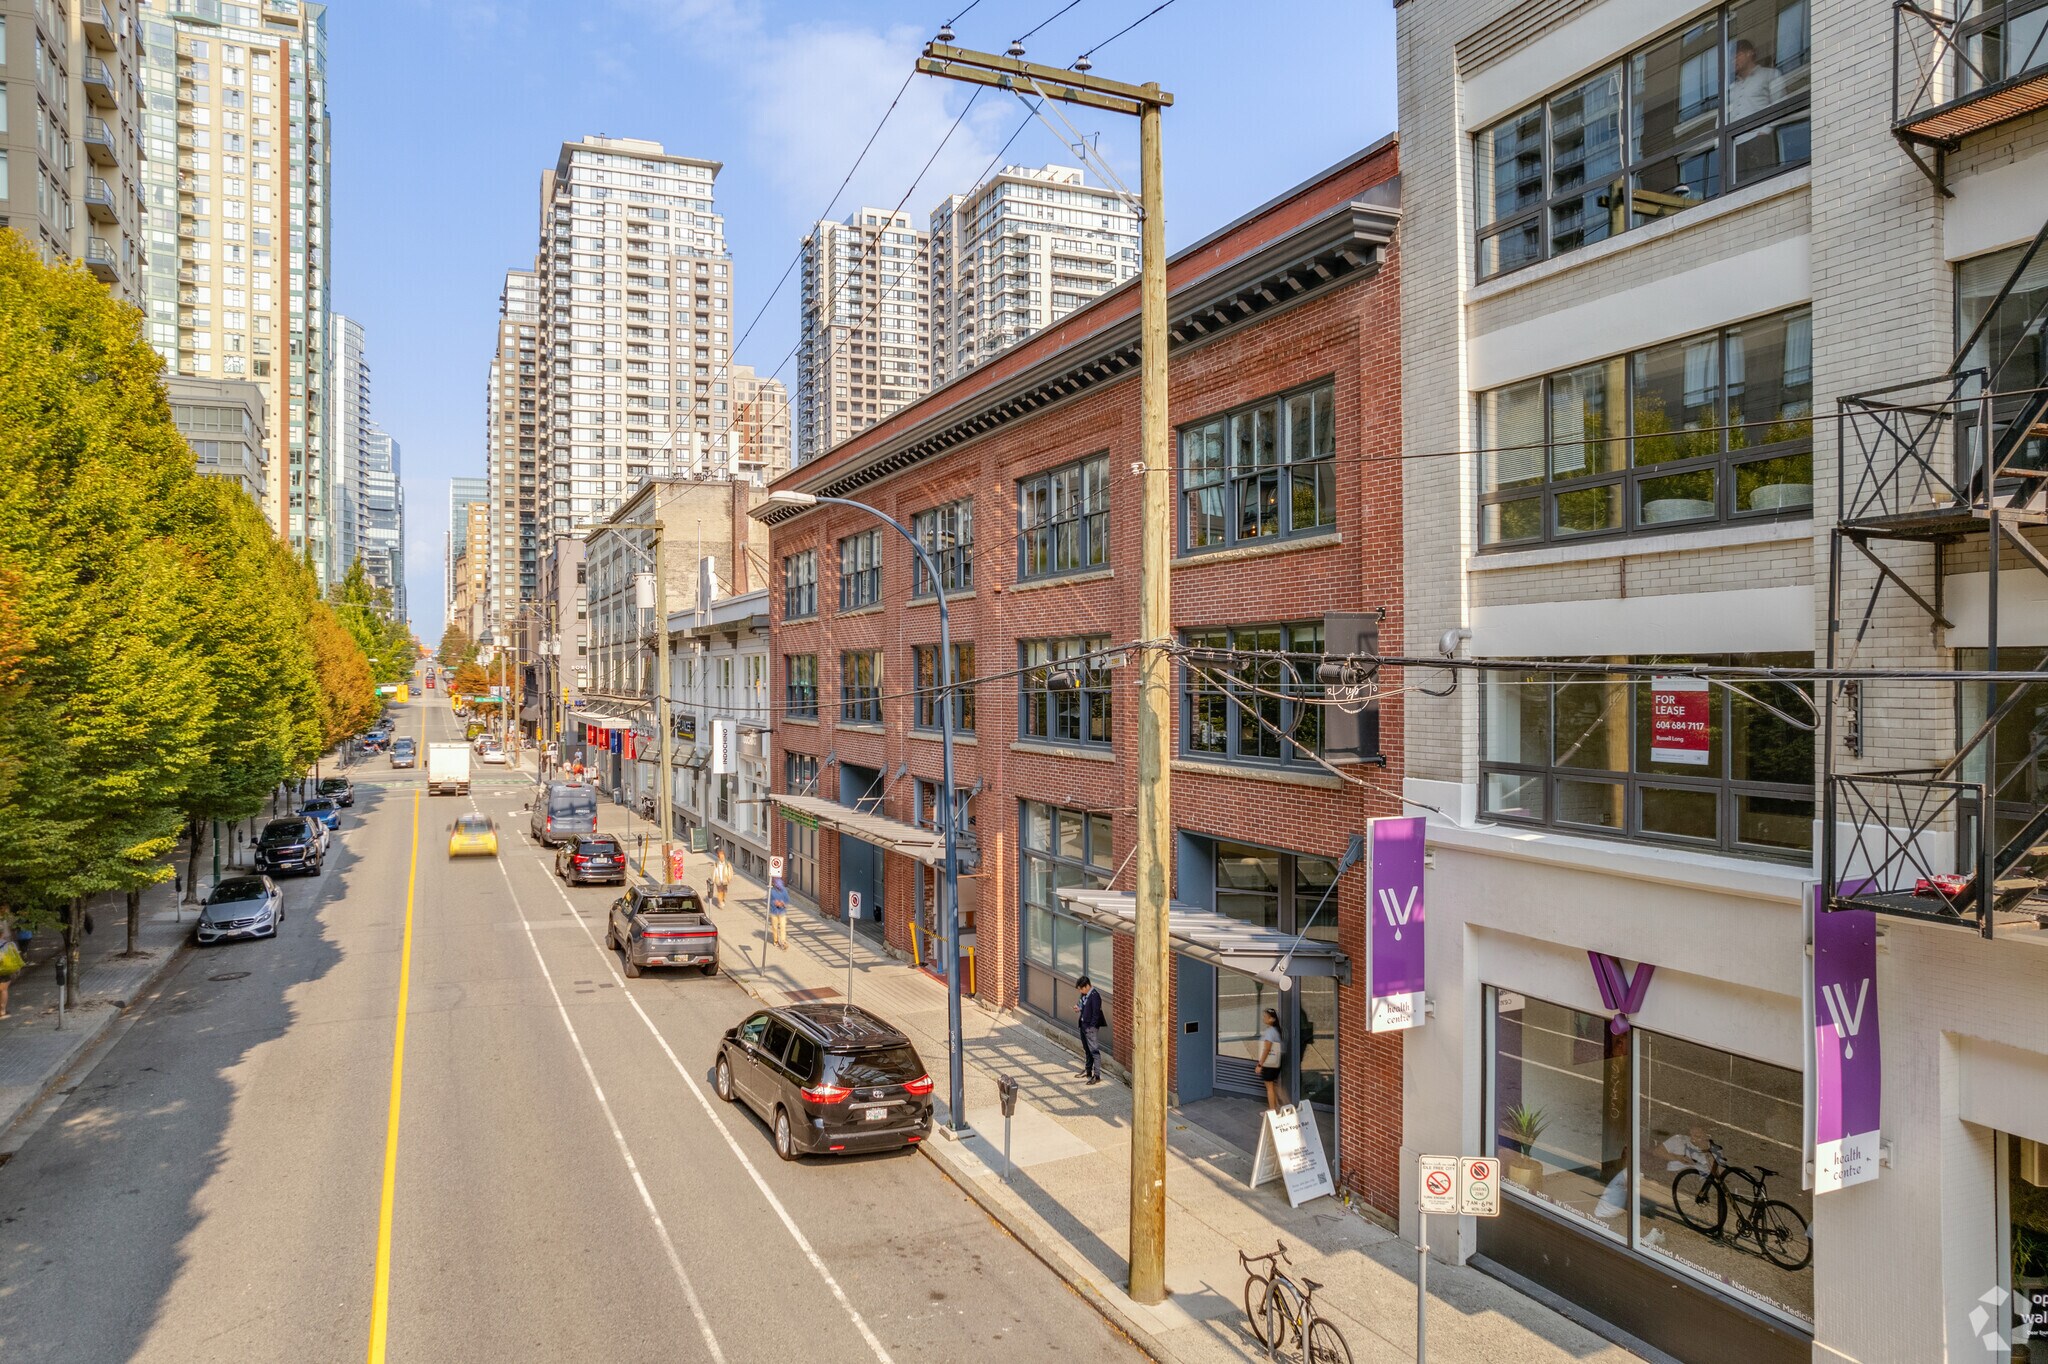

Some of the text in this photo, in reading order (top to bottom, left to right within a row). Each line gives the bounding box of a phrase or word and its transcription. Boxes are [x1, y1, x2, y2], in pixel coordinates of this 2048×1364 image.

[1655, 695, 1675, 704] FOR
[1655, 706, 1685, 715] LEASE
[1656, 721, 1704, 731] 604 684 7117
[1387, 1002, 1410, 1013] health
[1387, 1014, 1411, 1024] centre
[1834, 1146, 1861, 1165] health
[1833, 1165, 1861, 1180] centre
[1500, 1176, 1529, 1193] Osteopathy
[1536, 1190, 1549, 1200] RMT
[1563, 1202, 1584, 1217] Vitamin
[1586, 1212, 1610, 1229] Therapy
[1640, 1237, 1813, 1324] Registered Acupuncturist Naturopathic Medicin
[2032, 1294, 2048, 1307] op
[2020, 1310, 2048, 1324] wal
